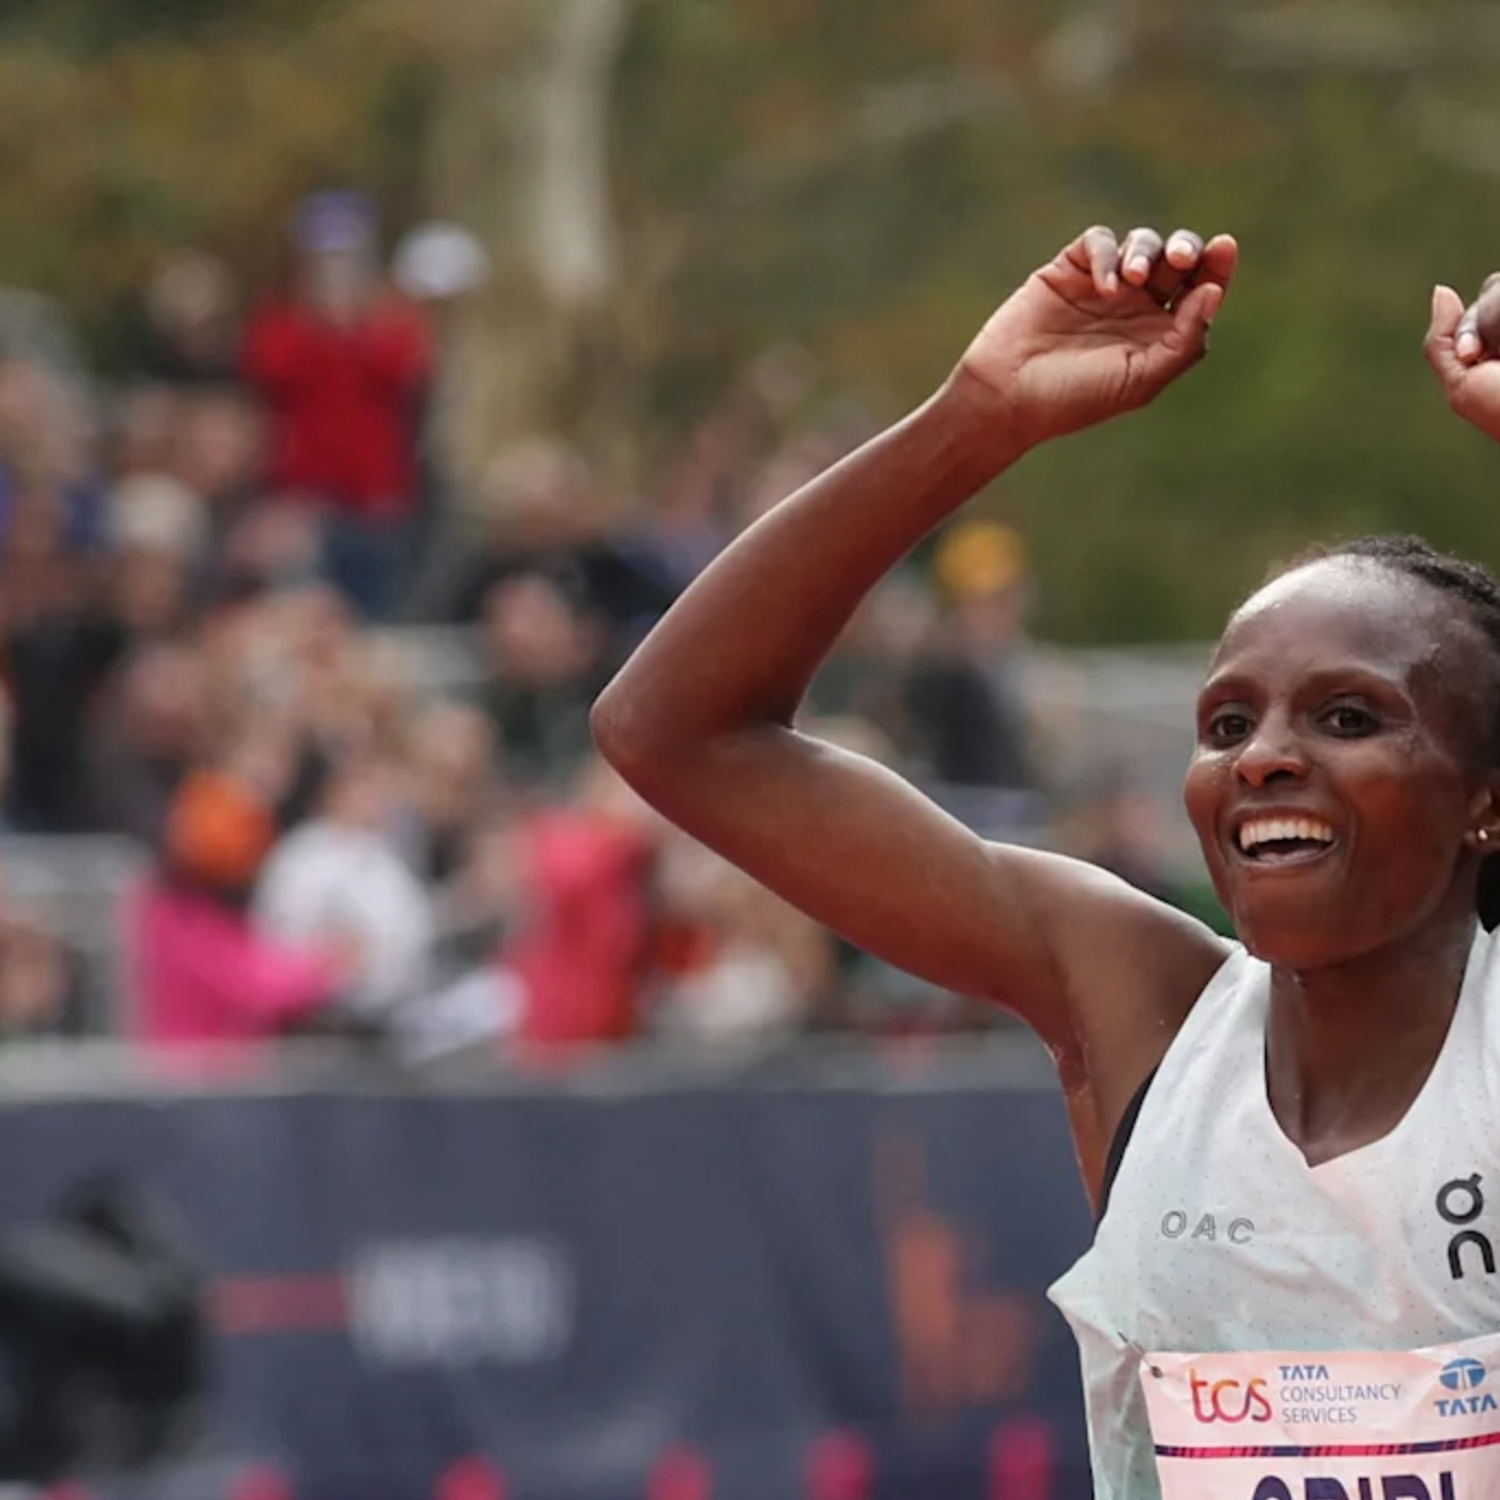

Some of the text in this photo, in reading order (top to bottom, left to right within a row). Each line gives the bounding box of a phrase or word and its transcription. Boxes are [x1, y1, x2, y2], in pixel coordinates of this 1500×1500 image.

[1161, 1210, 1255, 1244] OAC
[1278, 1365, 1329, 1380] TATA
[1189, 1367, 1273, 1424] tcs
[1279, 1383, 1401, 1402] CONSULTANCY
[1281, 1406, 1357, 1424] SERVICES
[1434, 1394, 1498, 1417] TATA
